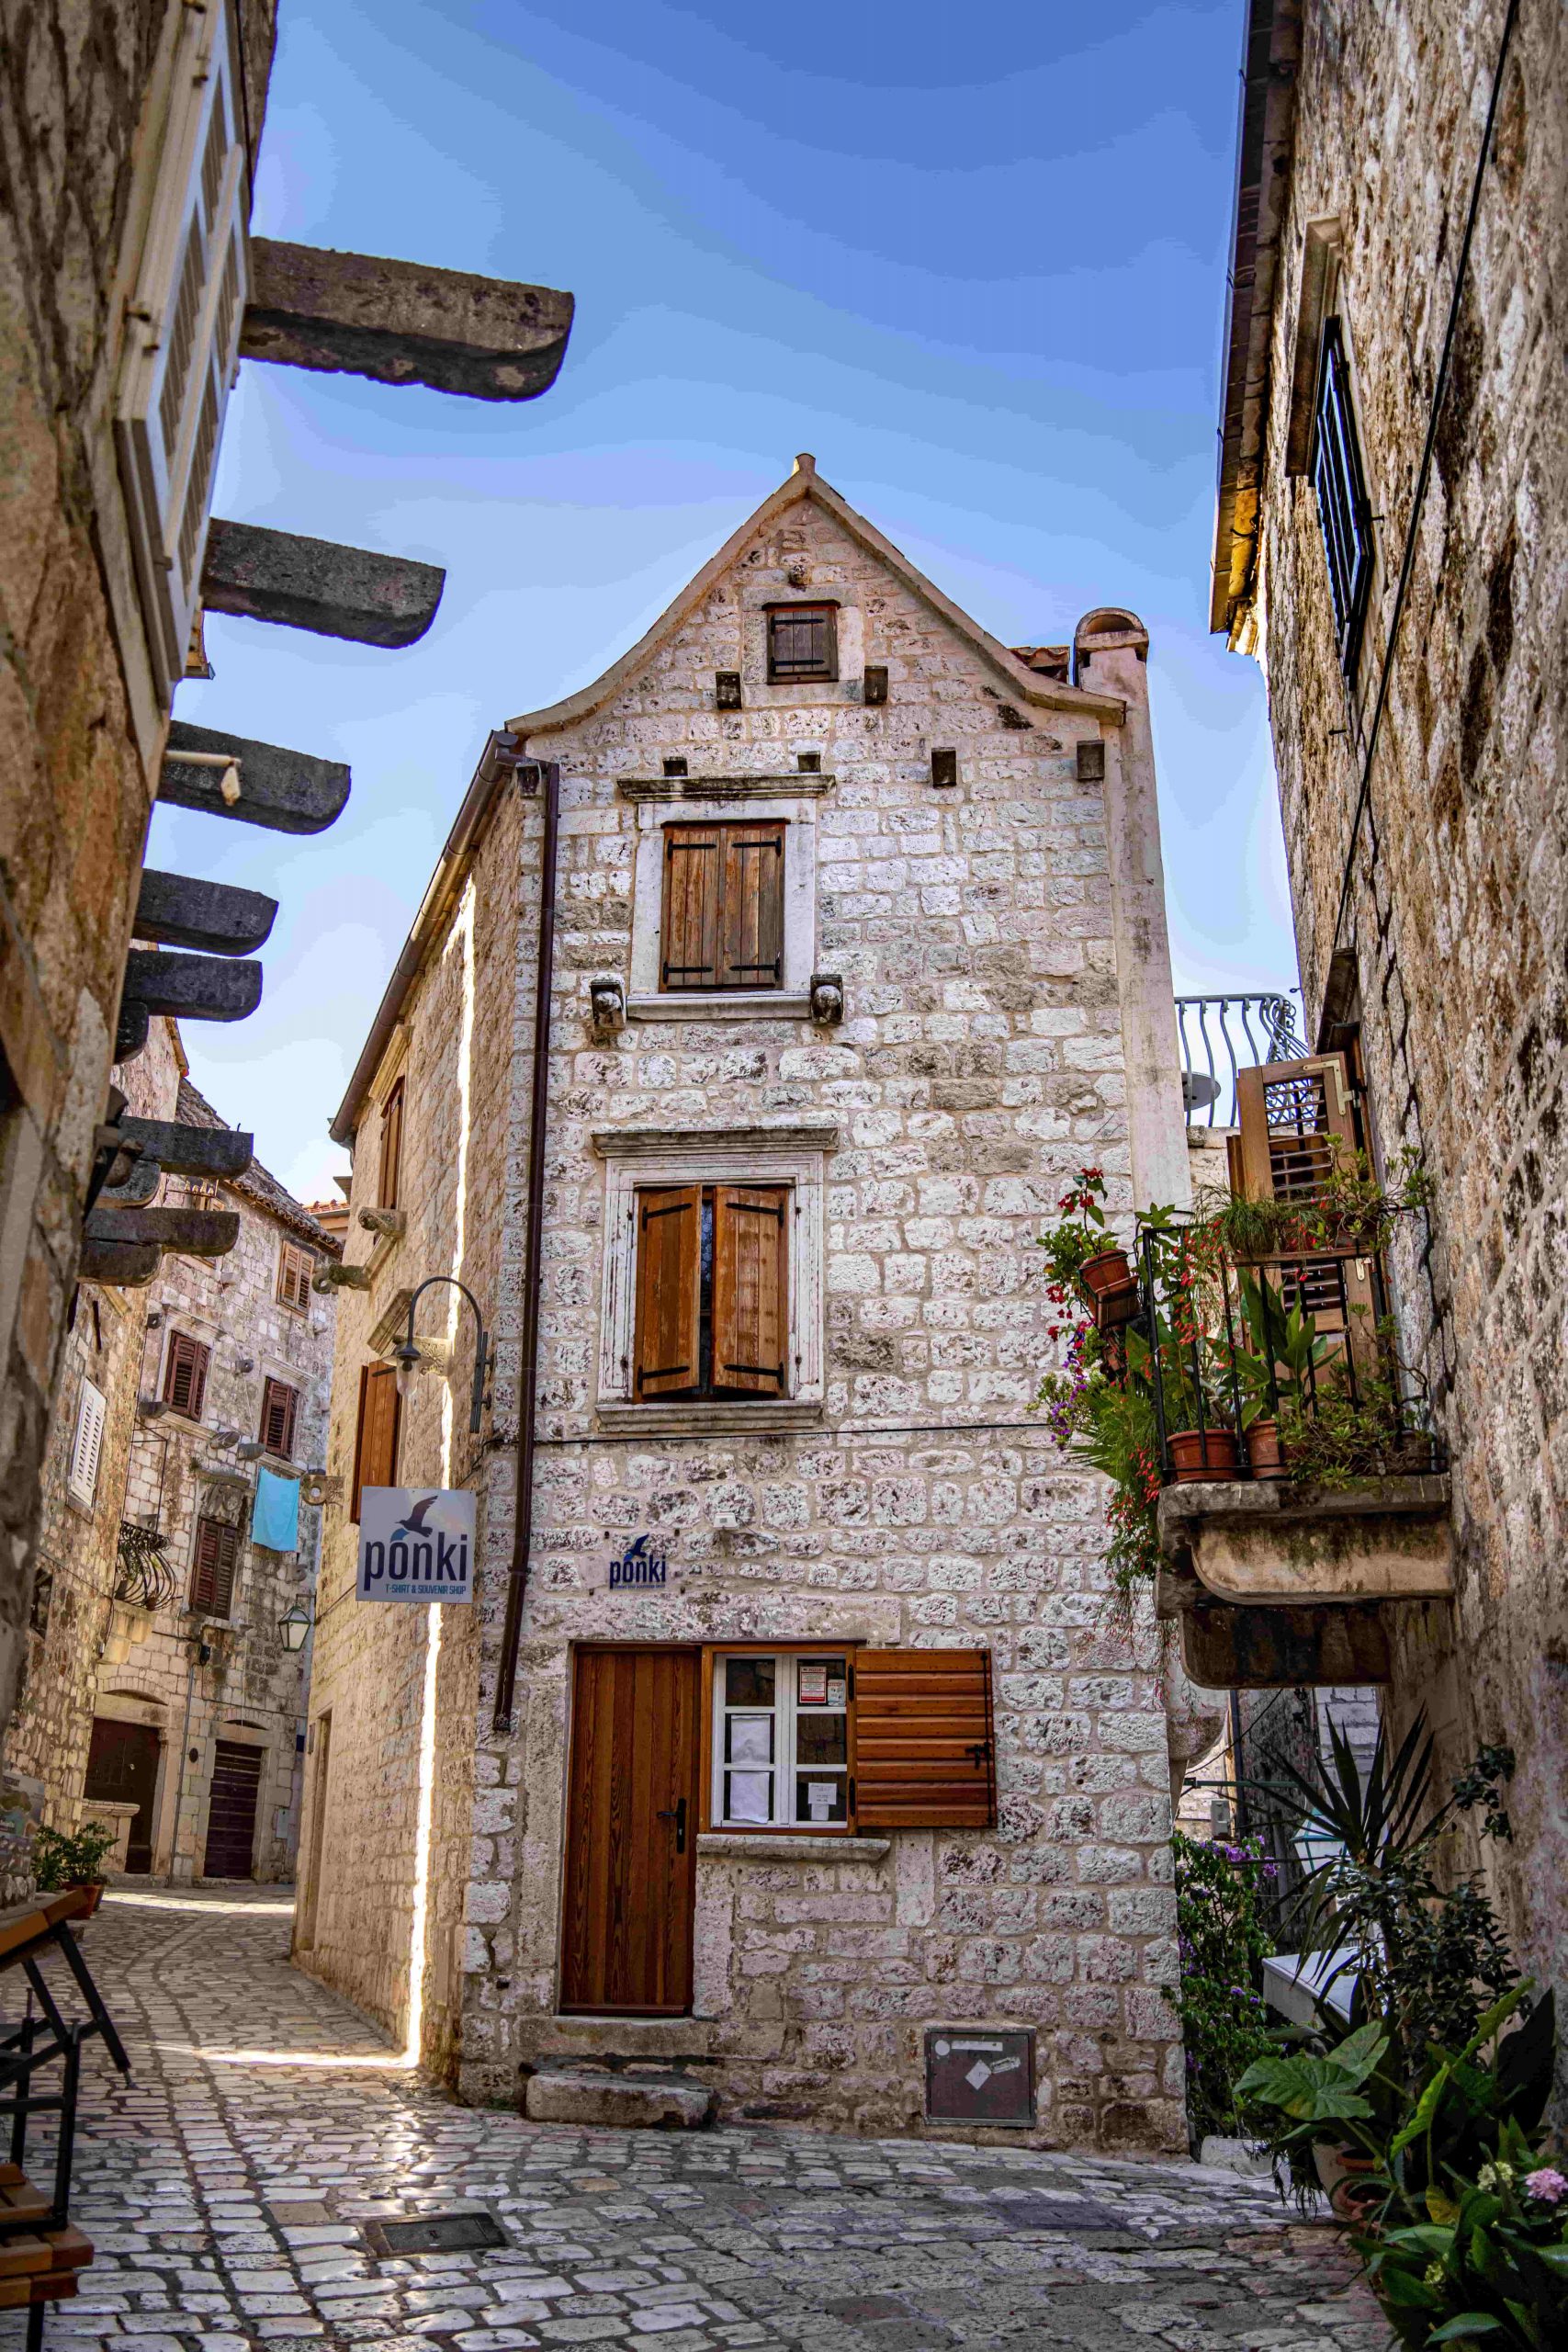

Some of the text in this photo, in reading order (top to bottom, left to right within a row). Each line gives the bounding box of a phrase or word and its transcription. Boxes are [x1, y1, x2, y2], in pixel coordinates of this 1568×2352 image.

[364, 1532, 468, 1592] ponki
[609, 1555, 666, 1589] ponki
[385, 1583, 467, 1595] T-SHIRT & SOUVENIR SHOP
